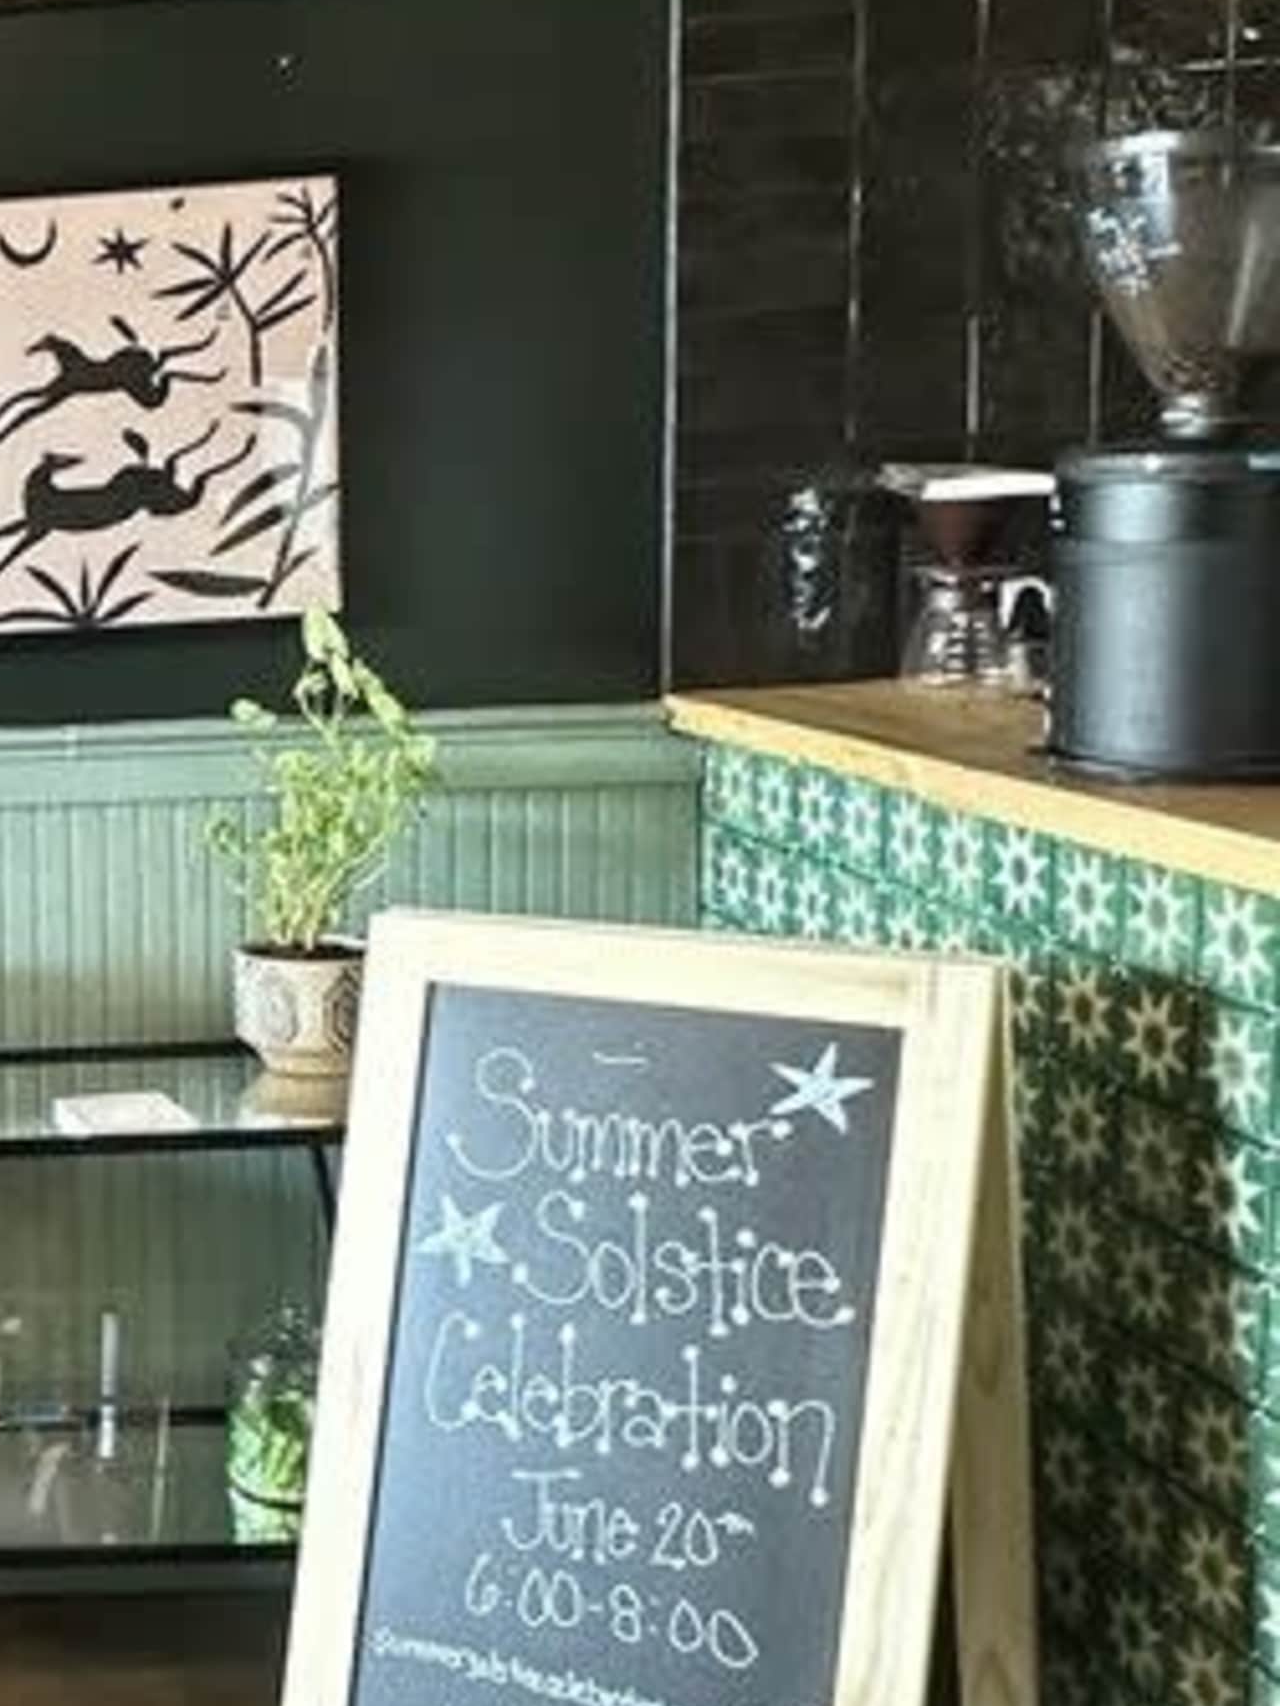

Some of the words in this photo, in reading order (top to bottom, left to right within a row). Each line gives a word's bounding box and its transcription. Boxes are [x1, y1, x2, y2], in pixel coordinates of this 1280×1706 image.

[447, 1047, 794, 1187] Summer
[512, 1190, 856, 1338] Solstice
[424, 1310, 834, 1507] Celebration
[500, 1469, 640, 1565] June
[464, 1552, 760, 1669] 6:00-8:00
